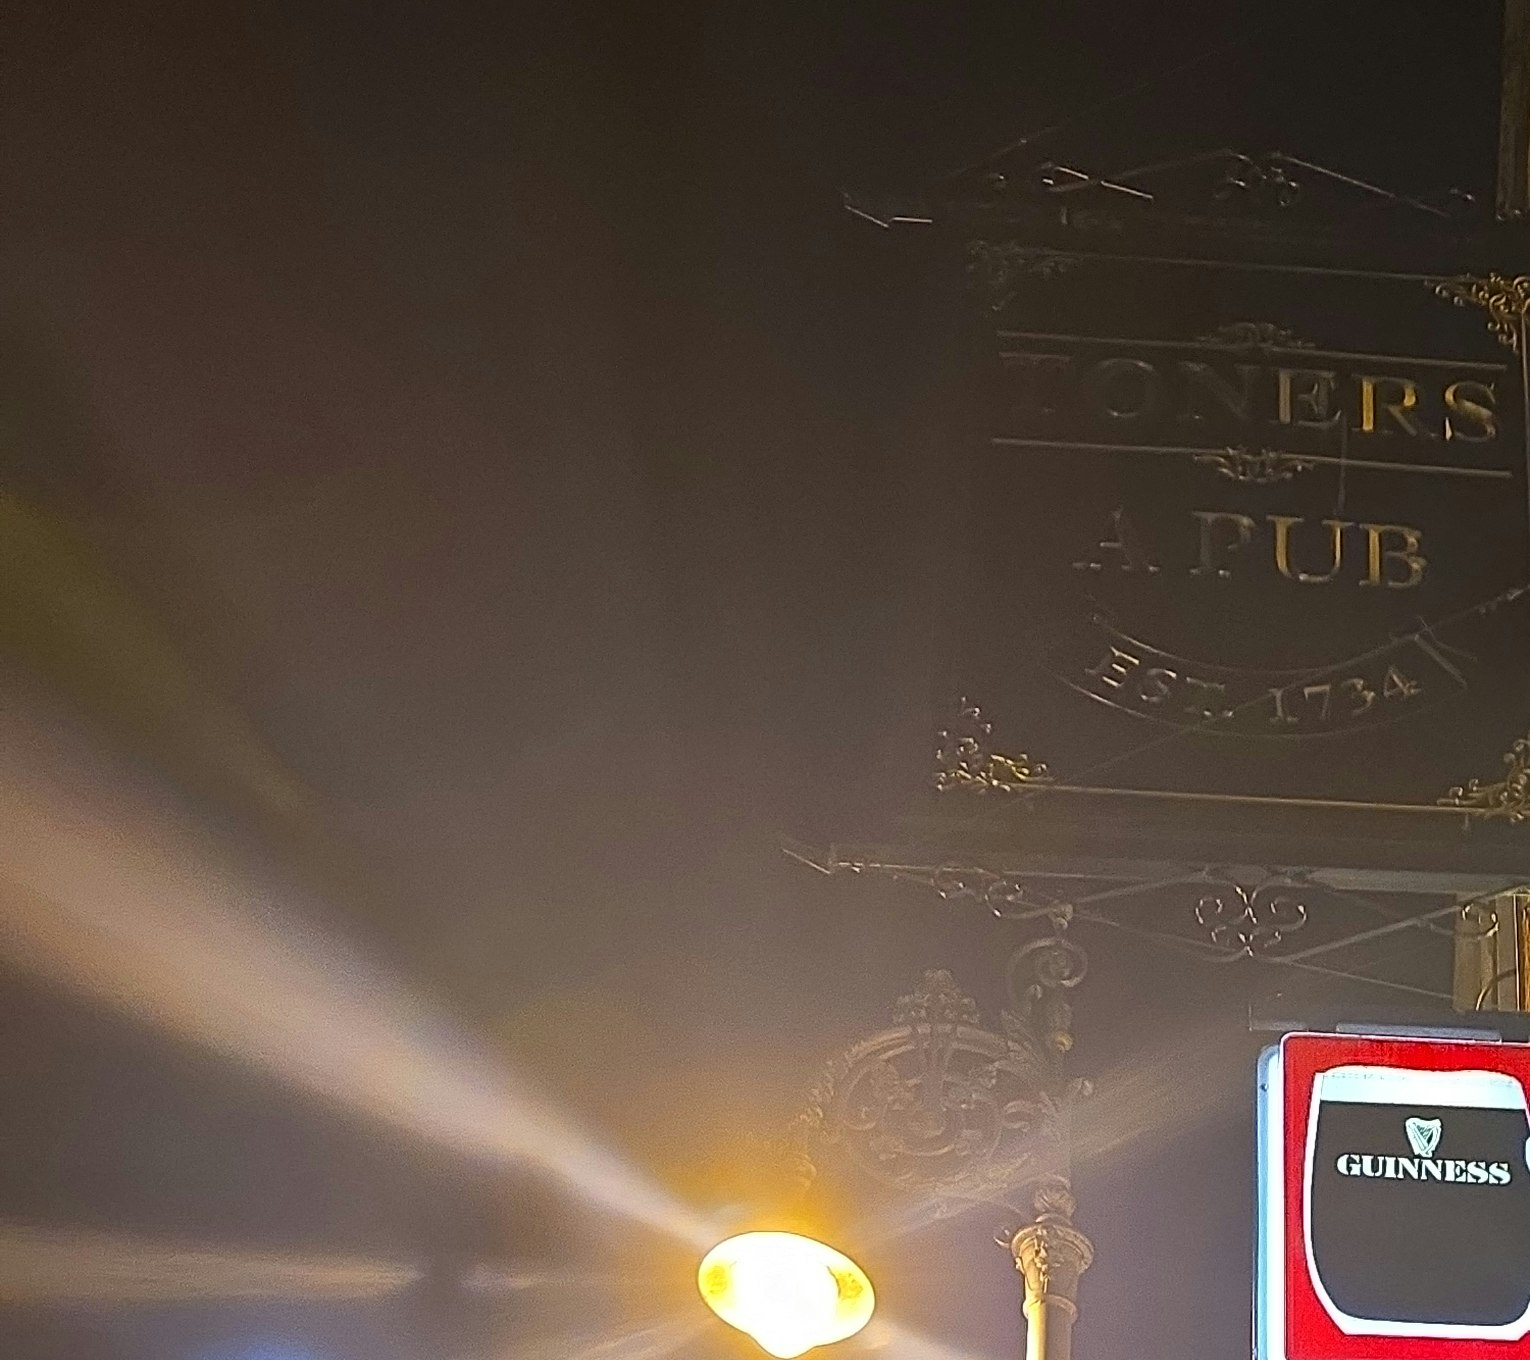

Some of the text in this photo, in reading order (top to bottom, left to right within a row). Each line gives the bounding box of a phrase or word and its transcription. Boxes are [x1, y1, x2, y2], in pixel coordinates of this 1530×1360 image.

[1188, 510, 1428, 588] PUB
[1266, 664, 1424, 724] 1734
[1336, 1152, 1514, 1186] GUINNESS
